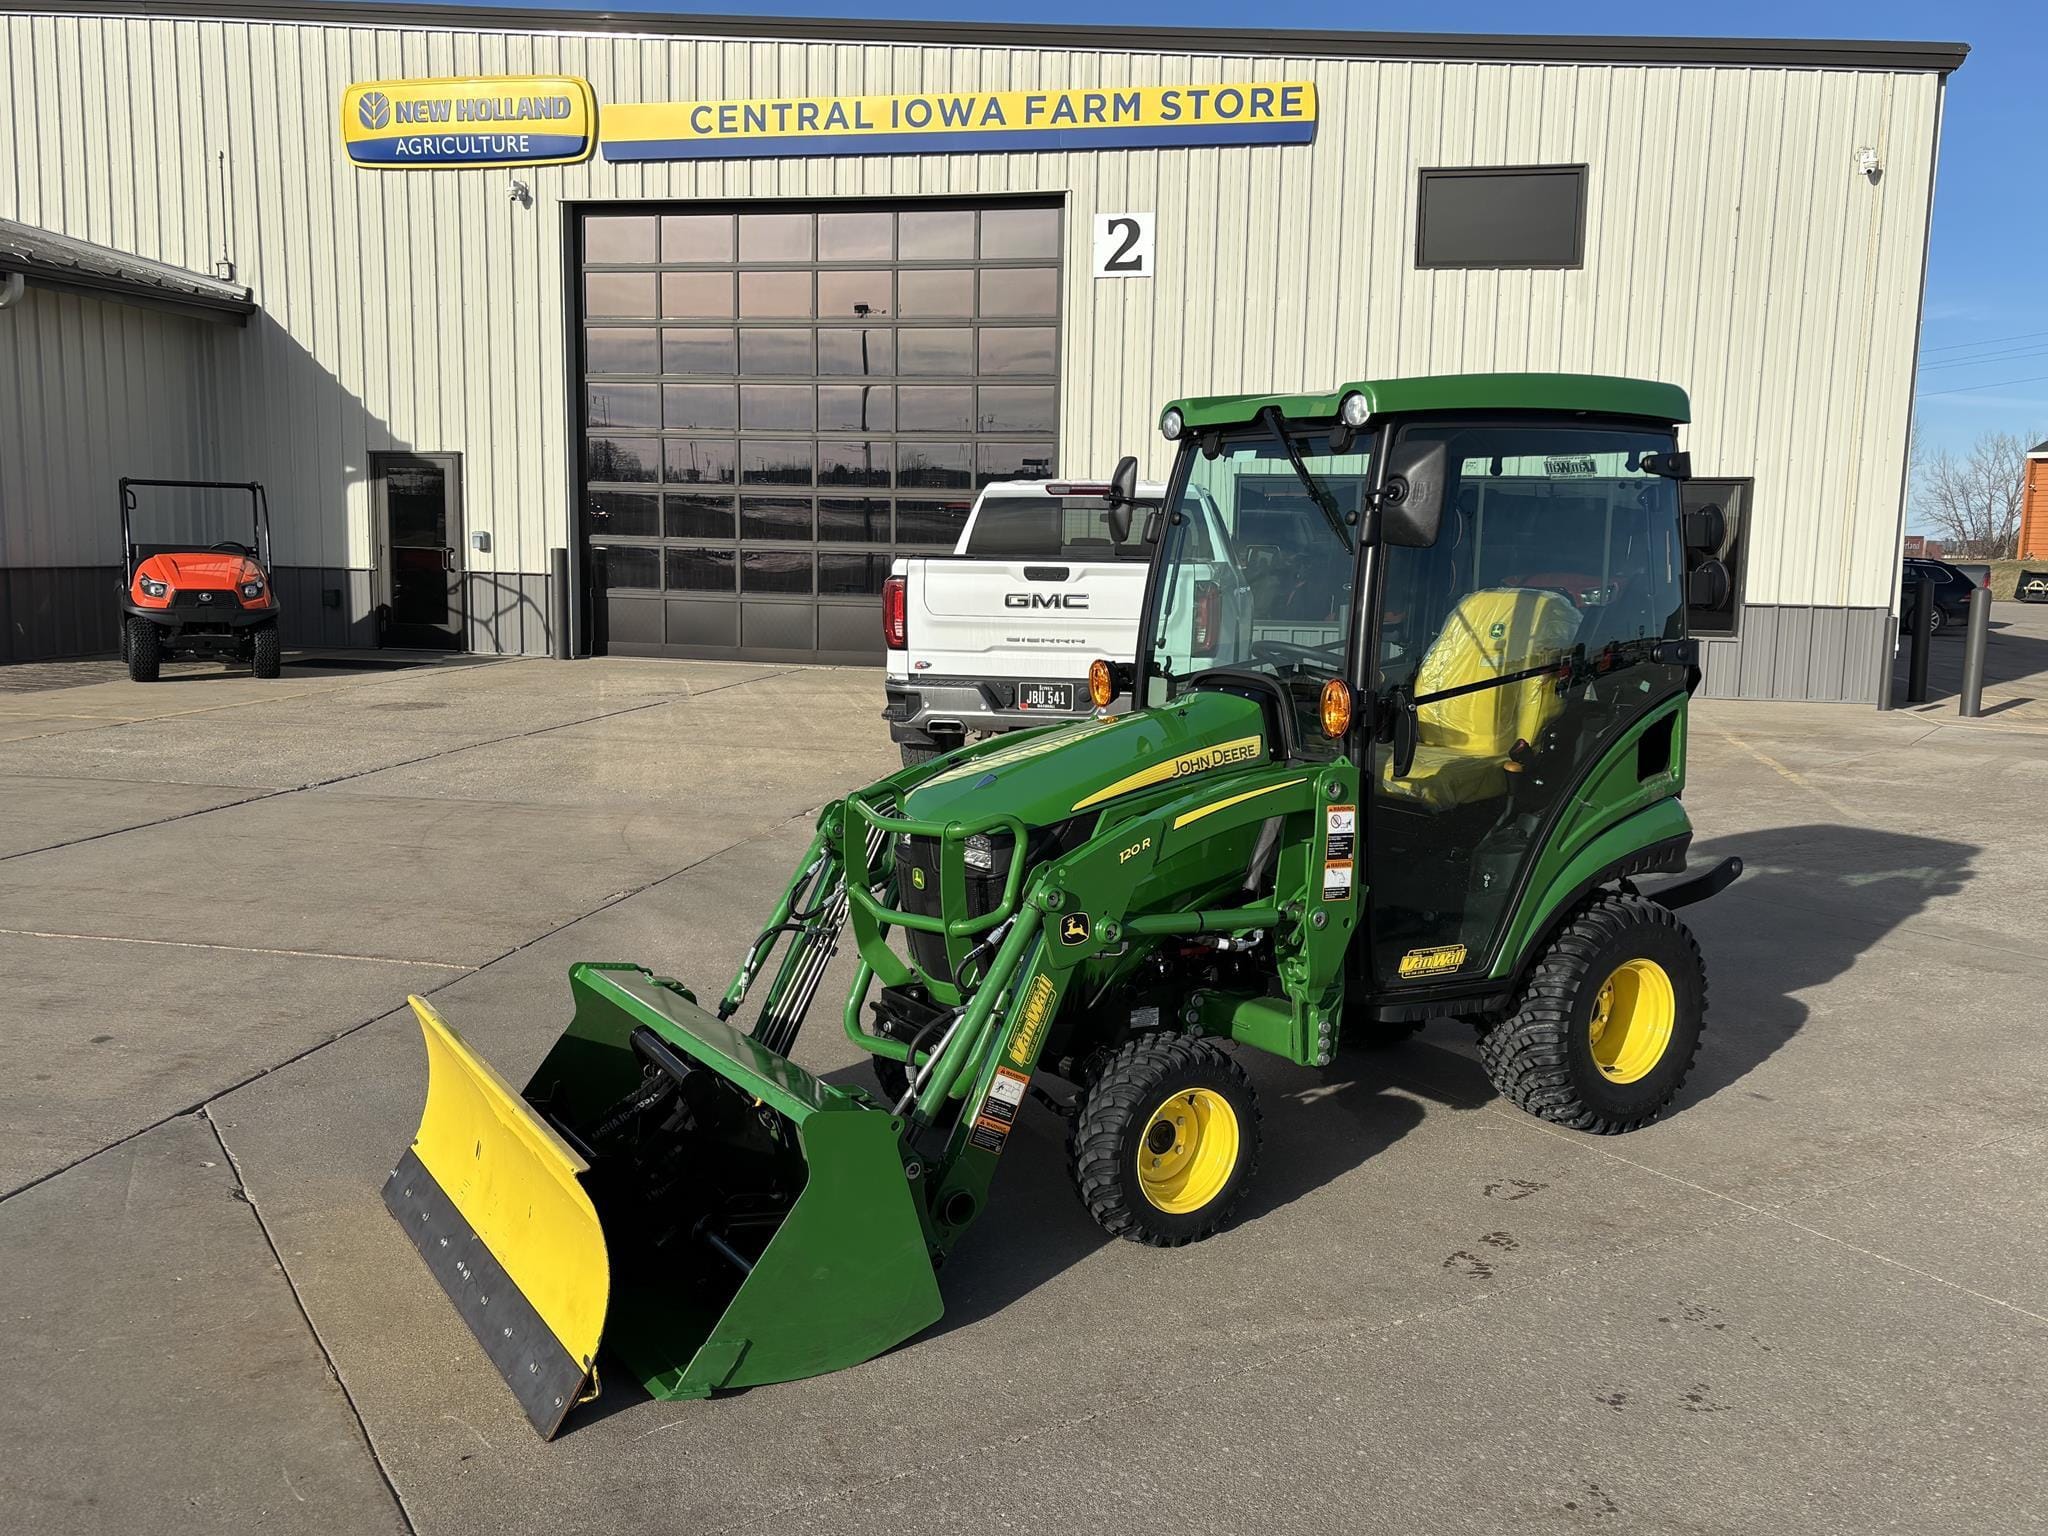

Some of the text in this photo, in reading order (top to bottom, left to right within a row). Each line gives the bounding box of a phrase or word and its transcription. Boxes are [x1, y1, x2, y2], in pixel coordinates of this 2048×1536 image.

[396, 96, 571, 124] NEW HOLLAND
[690, 86, 1304, 135] CENTRAL IOWA FARM STORE
[396, 135, 530, 155] AGRICULTURE
[1104, 217, 1143, 272] 2
[1004, 593, 1089, 609] GMC
[1026, 690, 1066, 705] JBU 541
[1172, 744, 1256, 777] JOHN DEERE
[1400, 950, 1466, 972] VanWall
